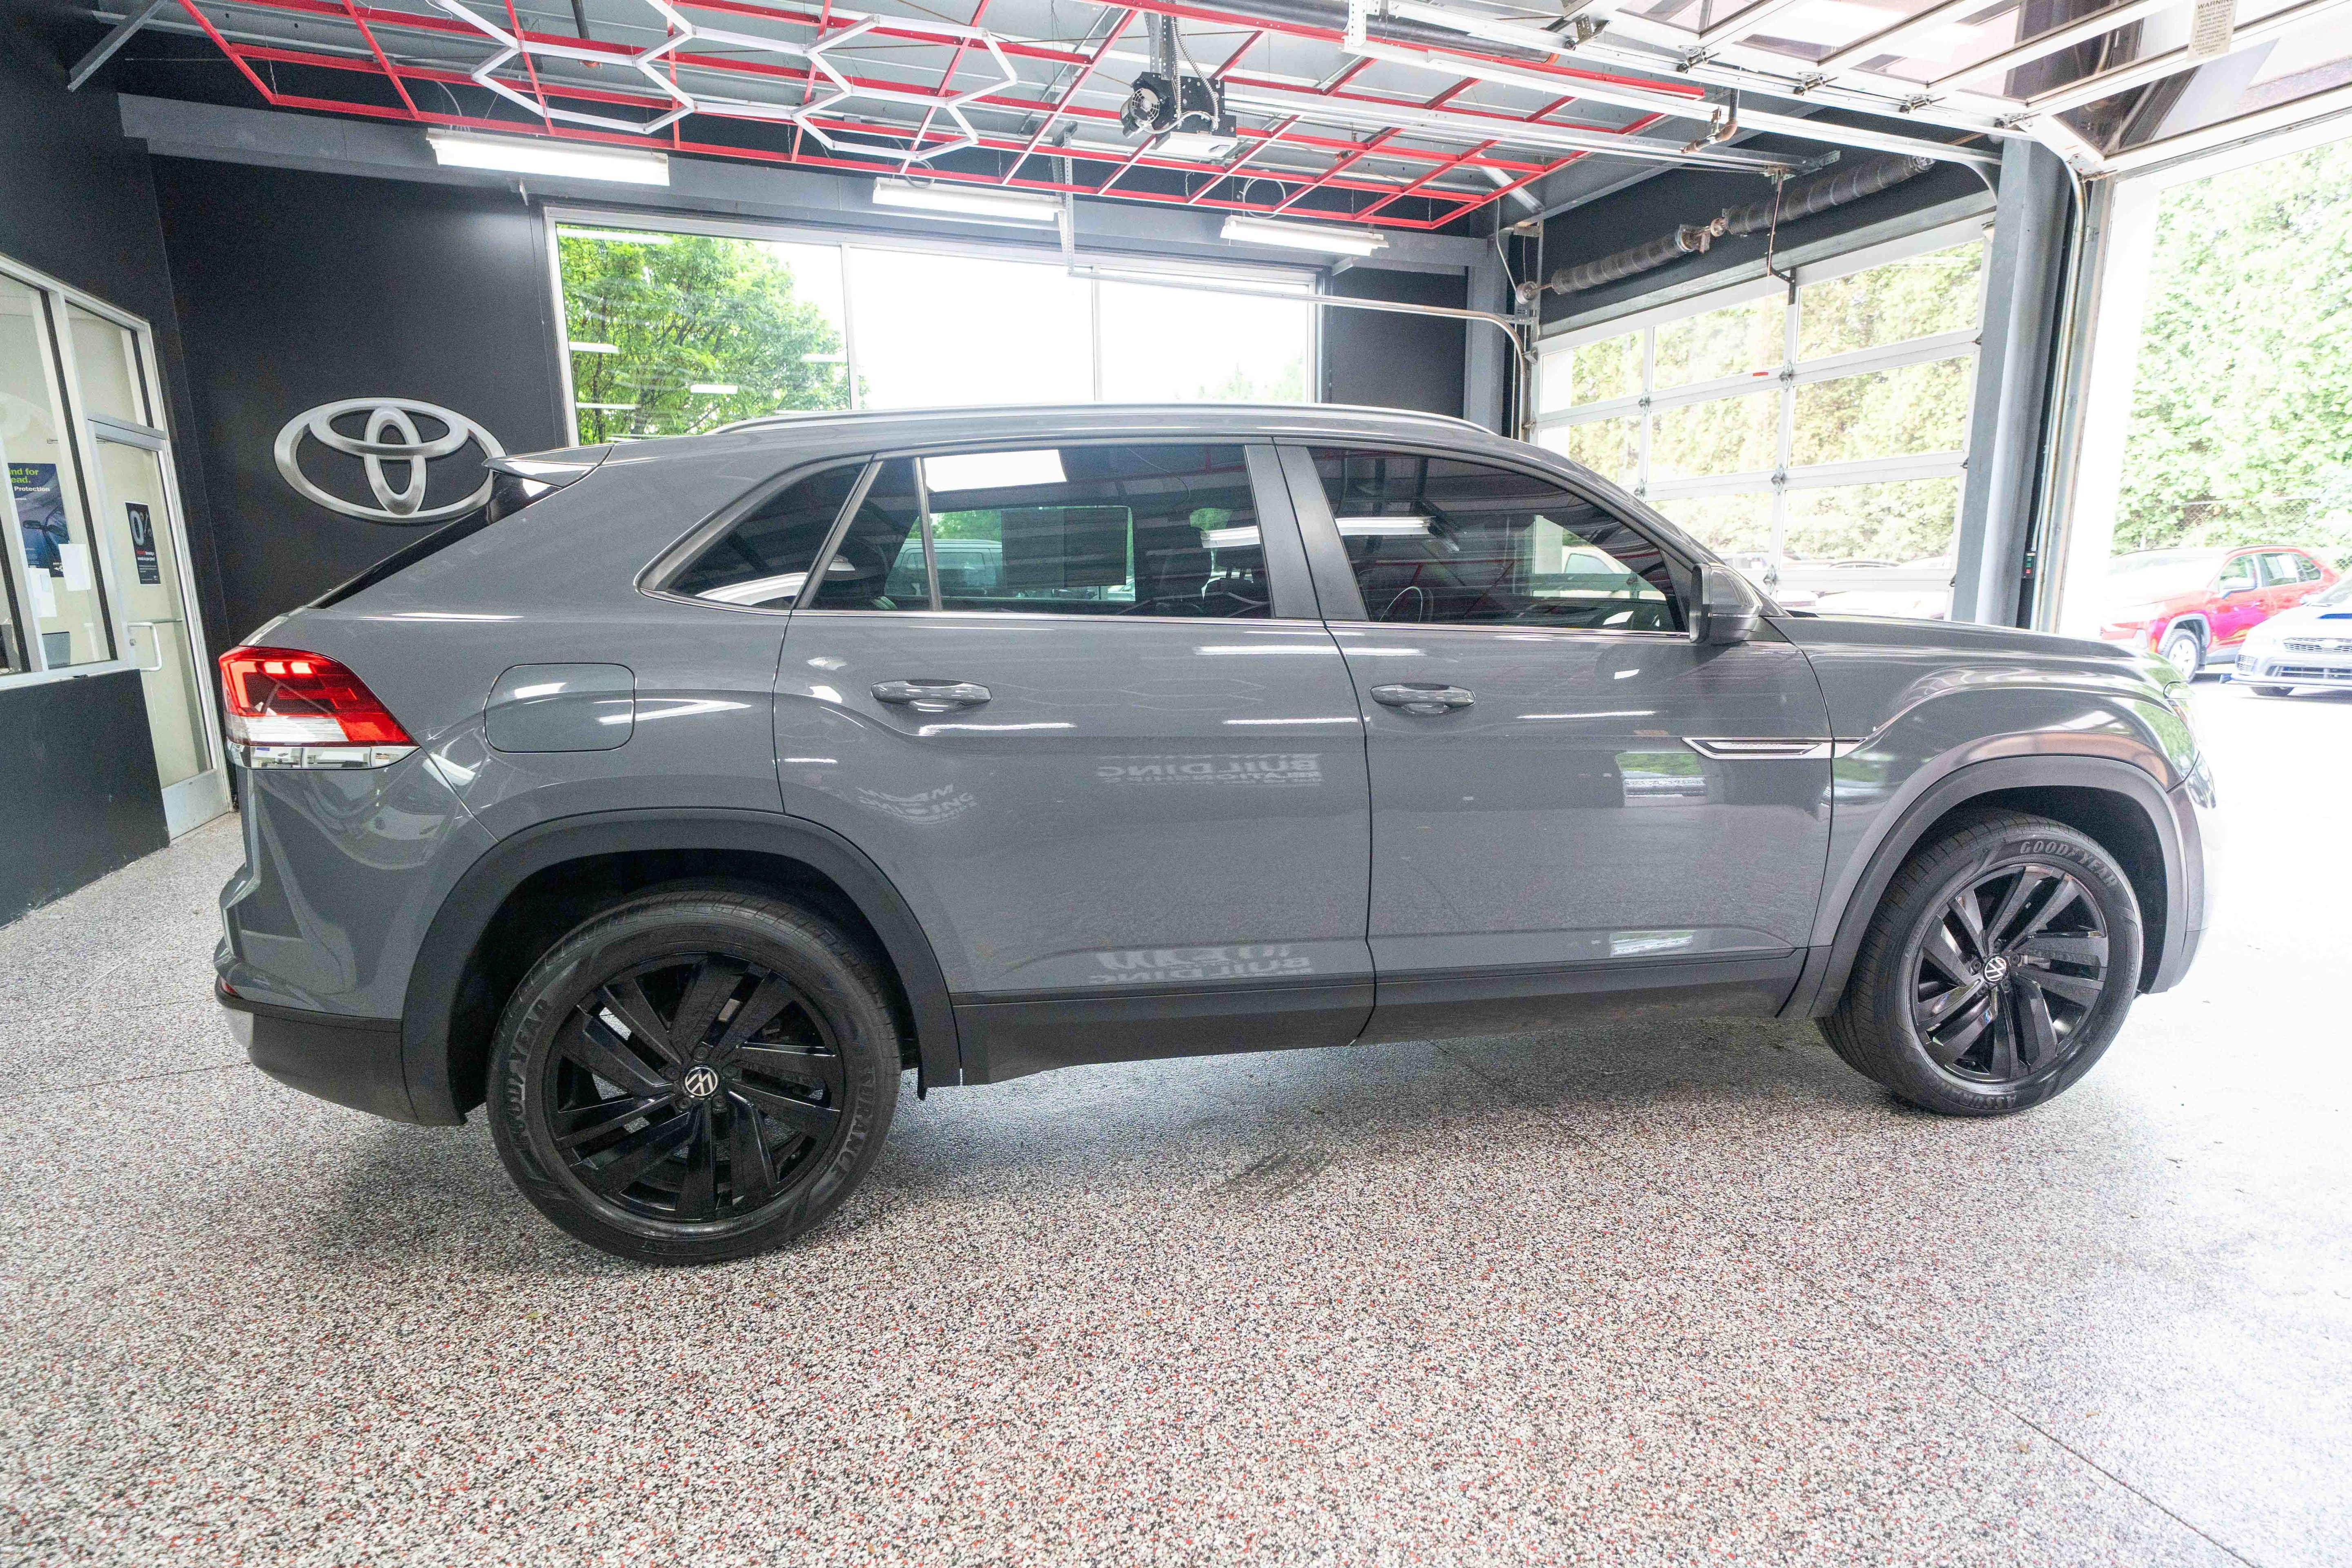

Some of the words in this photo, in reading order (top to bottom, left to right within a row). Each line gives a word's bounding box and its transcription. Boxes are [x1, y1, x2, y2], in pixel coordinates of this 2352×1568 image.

[11, 476, 31, 484] ead.
[2020, 840, 2117, 888] GOODYEAR
[508, 996, 552, 1152] GOODYEAR
